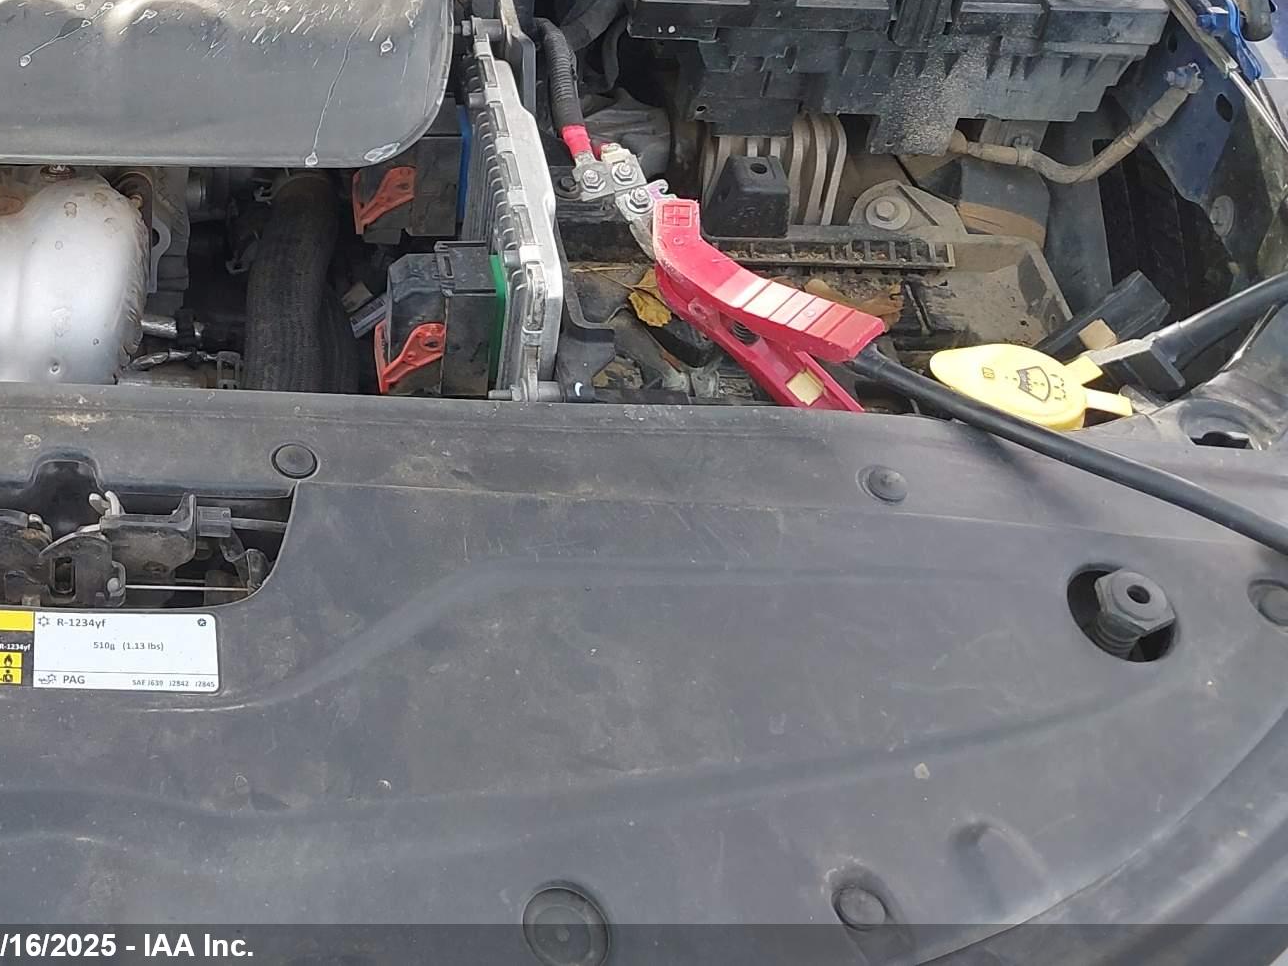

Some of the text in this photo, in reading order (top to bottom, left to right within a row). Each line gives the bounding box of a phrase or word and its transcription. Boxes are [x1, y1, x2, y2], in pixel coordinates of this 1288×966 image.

[56, 618, 106, 629] R-1234yf
[0, 643, 30, 651] R-1234yf
[122, 641, 145, 651] (1.13
[147, 641, 164, 651] lbs)
[62, 674, 86, 685] PAG
